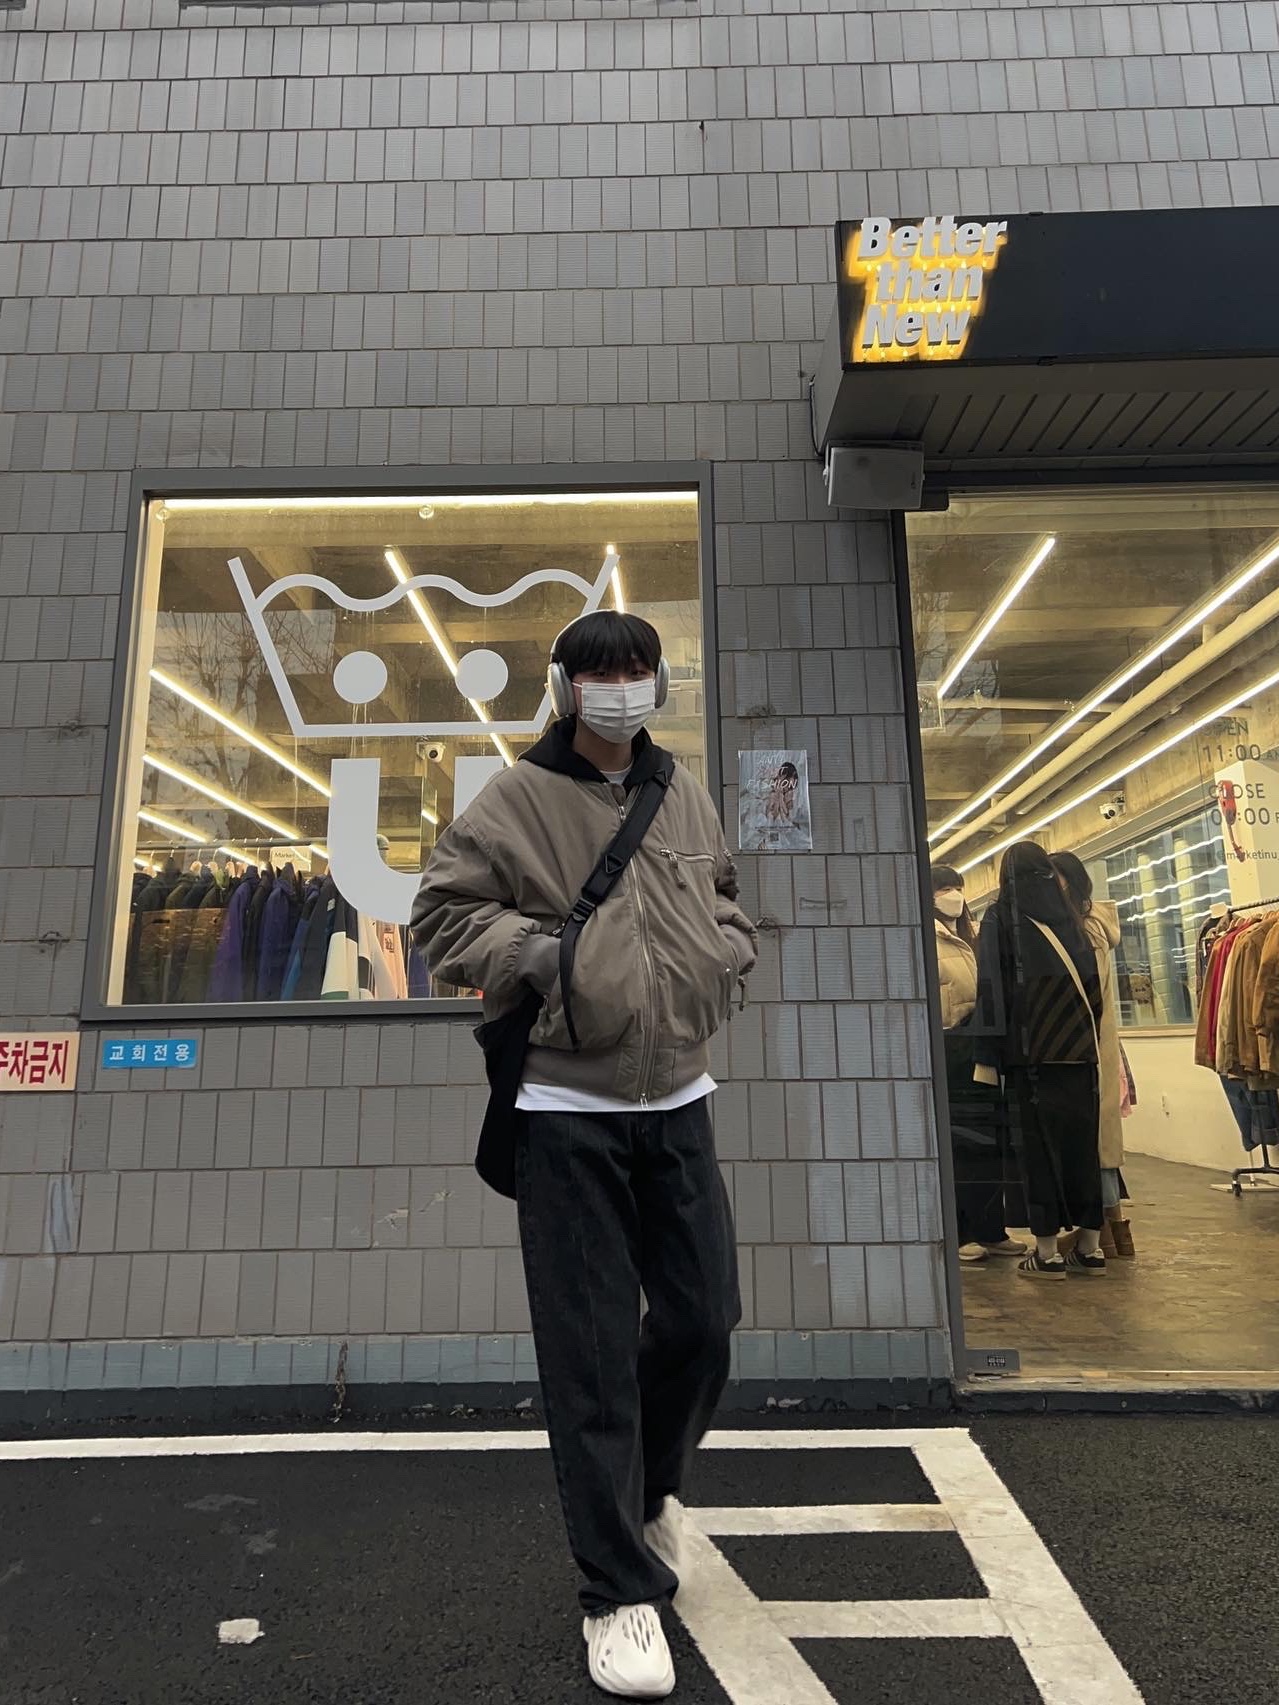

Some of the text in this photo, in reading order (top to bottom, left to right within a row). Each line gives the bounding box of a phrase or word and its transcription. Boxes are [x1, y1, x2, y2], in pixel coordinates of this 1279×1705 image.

[857, 215, 1008, 261] Better
[876, 257, 984, 303] than
[861, 303, 971, 348] New
[1202, 743, 1261, 763] 11:00
[1210, 807, 1271, 826] 0:00
[109, 1043, 191, 1062] 교회전용
